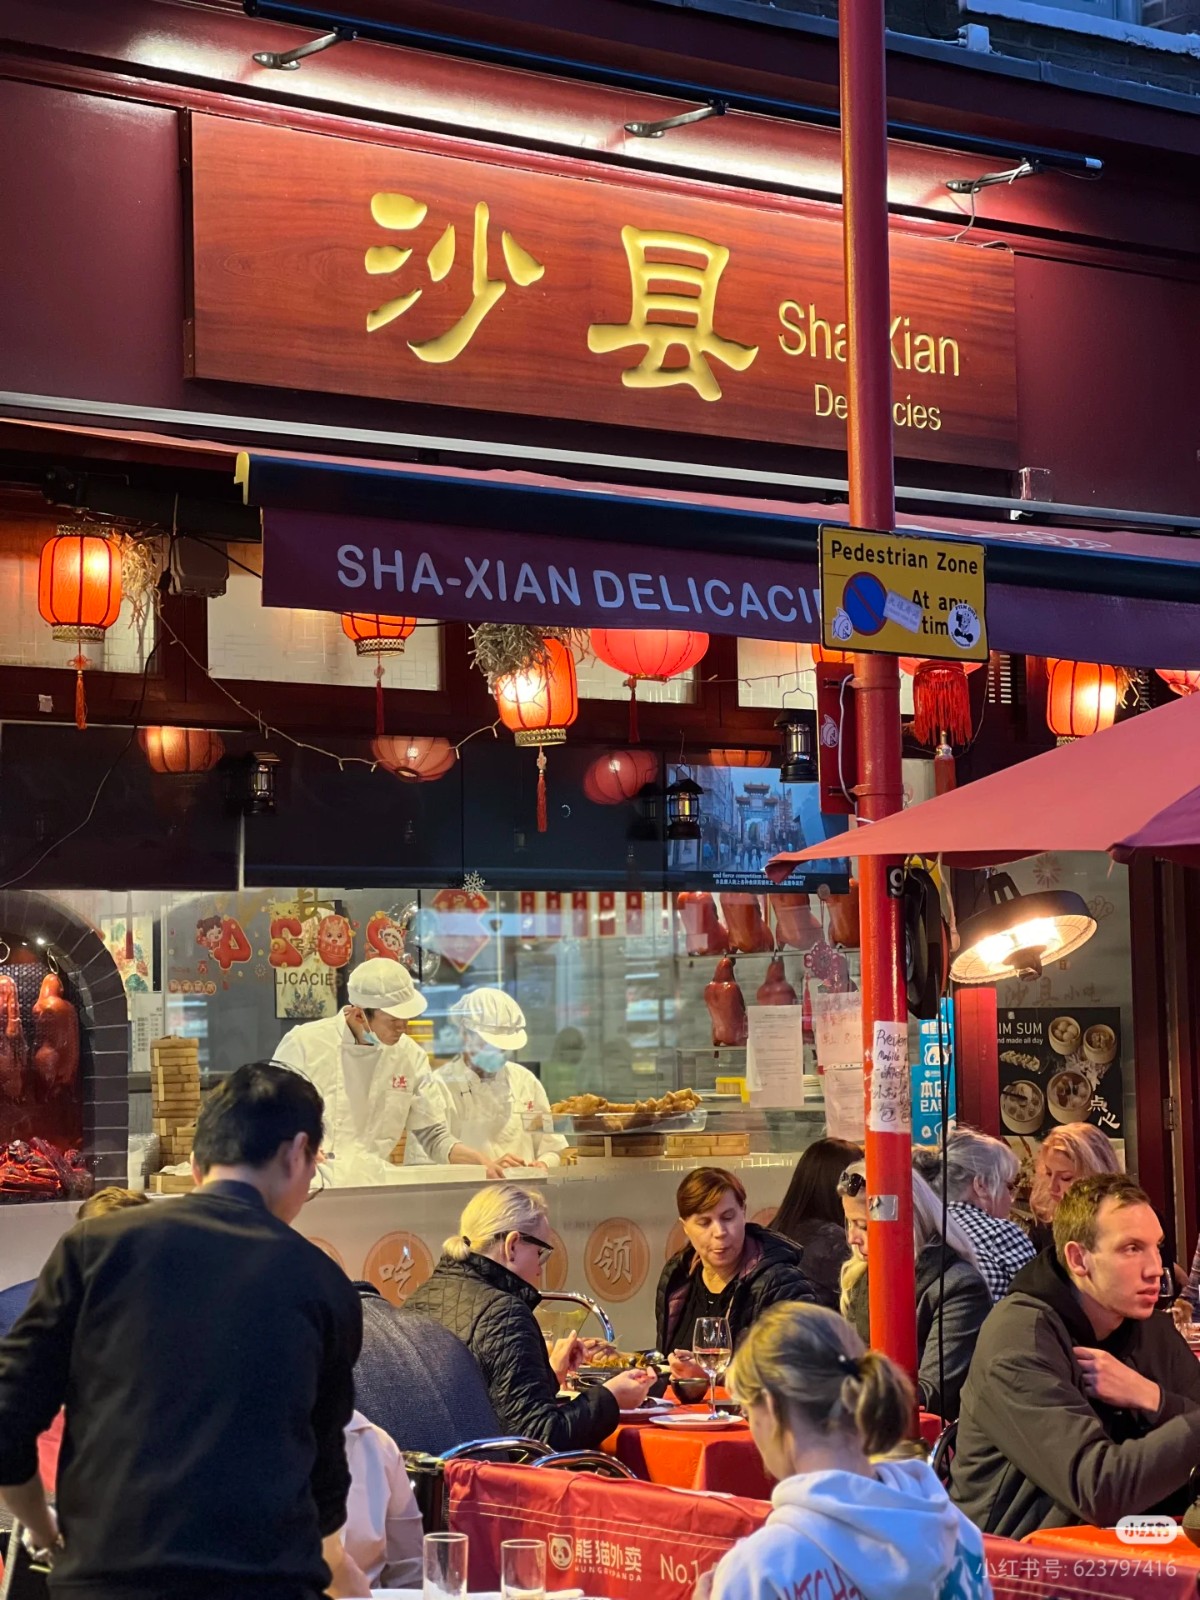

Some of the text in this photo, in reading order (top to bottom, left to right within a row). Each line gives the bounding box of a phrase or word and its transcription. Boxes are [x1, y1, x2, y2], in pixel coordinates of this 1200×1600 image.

[365, 191, 759, 402] 沙县
[831, 540, 978, 575] Pedestrian Zone
[337, 544, 581, 606] SHA-XIAN
[593, 569, 820, 623] DELICACI
[912, 590, 930, 610] At
[922, 616, 949, 636] tim
[1016, 1022, 1042, 1035] SUM
[1031, 1037, 1044, 1046] day
[575, 1537, 643, 1574] 熊猫外卖
